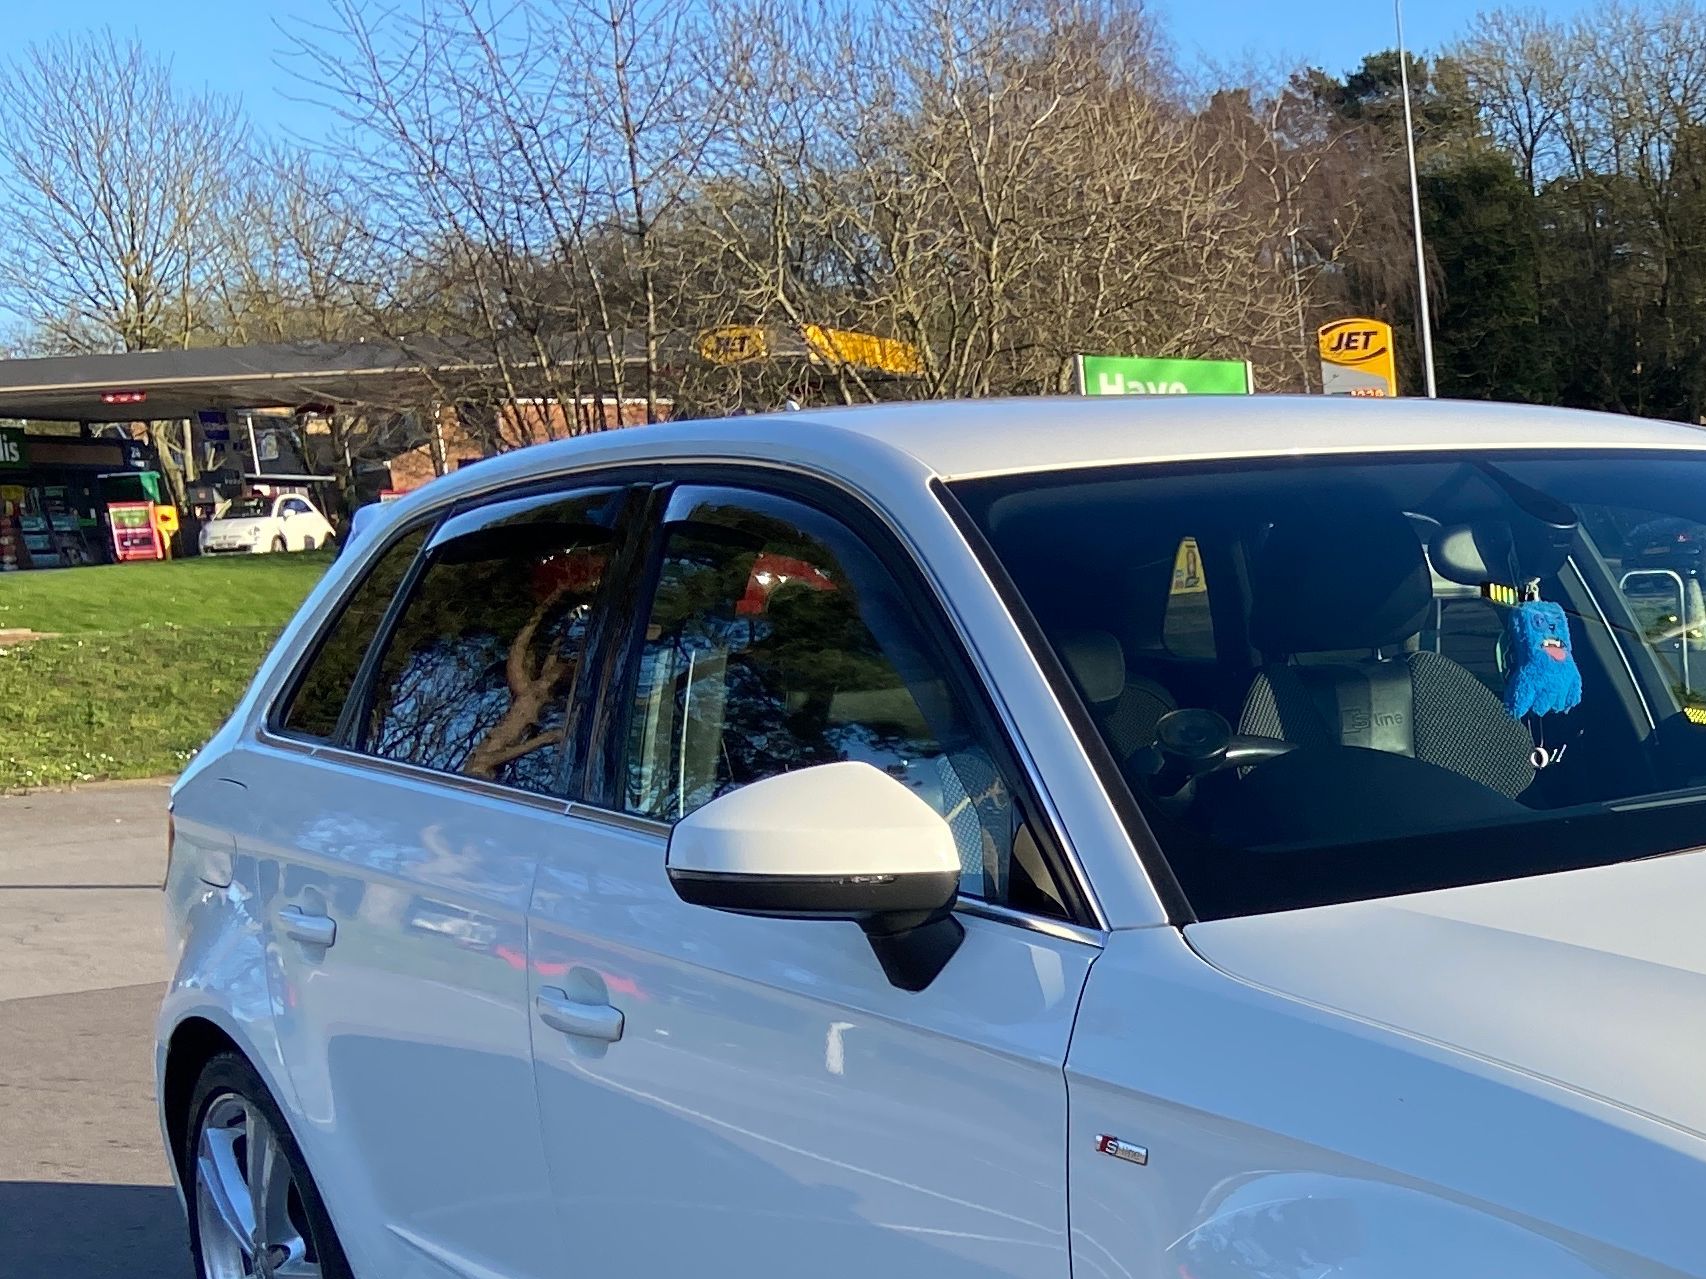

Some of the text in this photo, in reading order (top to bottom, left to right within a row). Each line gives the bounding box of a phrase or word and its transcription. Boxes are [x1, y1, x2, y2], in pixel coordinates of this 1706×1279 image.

[1330, 330, 1378, 352] JET
[1374, 712, 1404, 727] line
[1105, 1139, 1119, 1155] S
